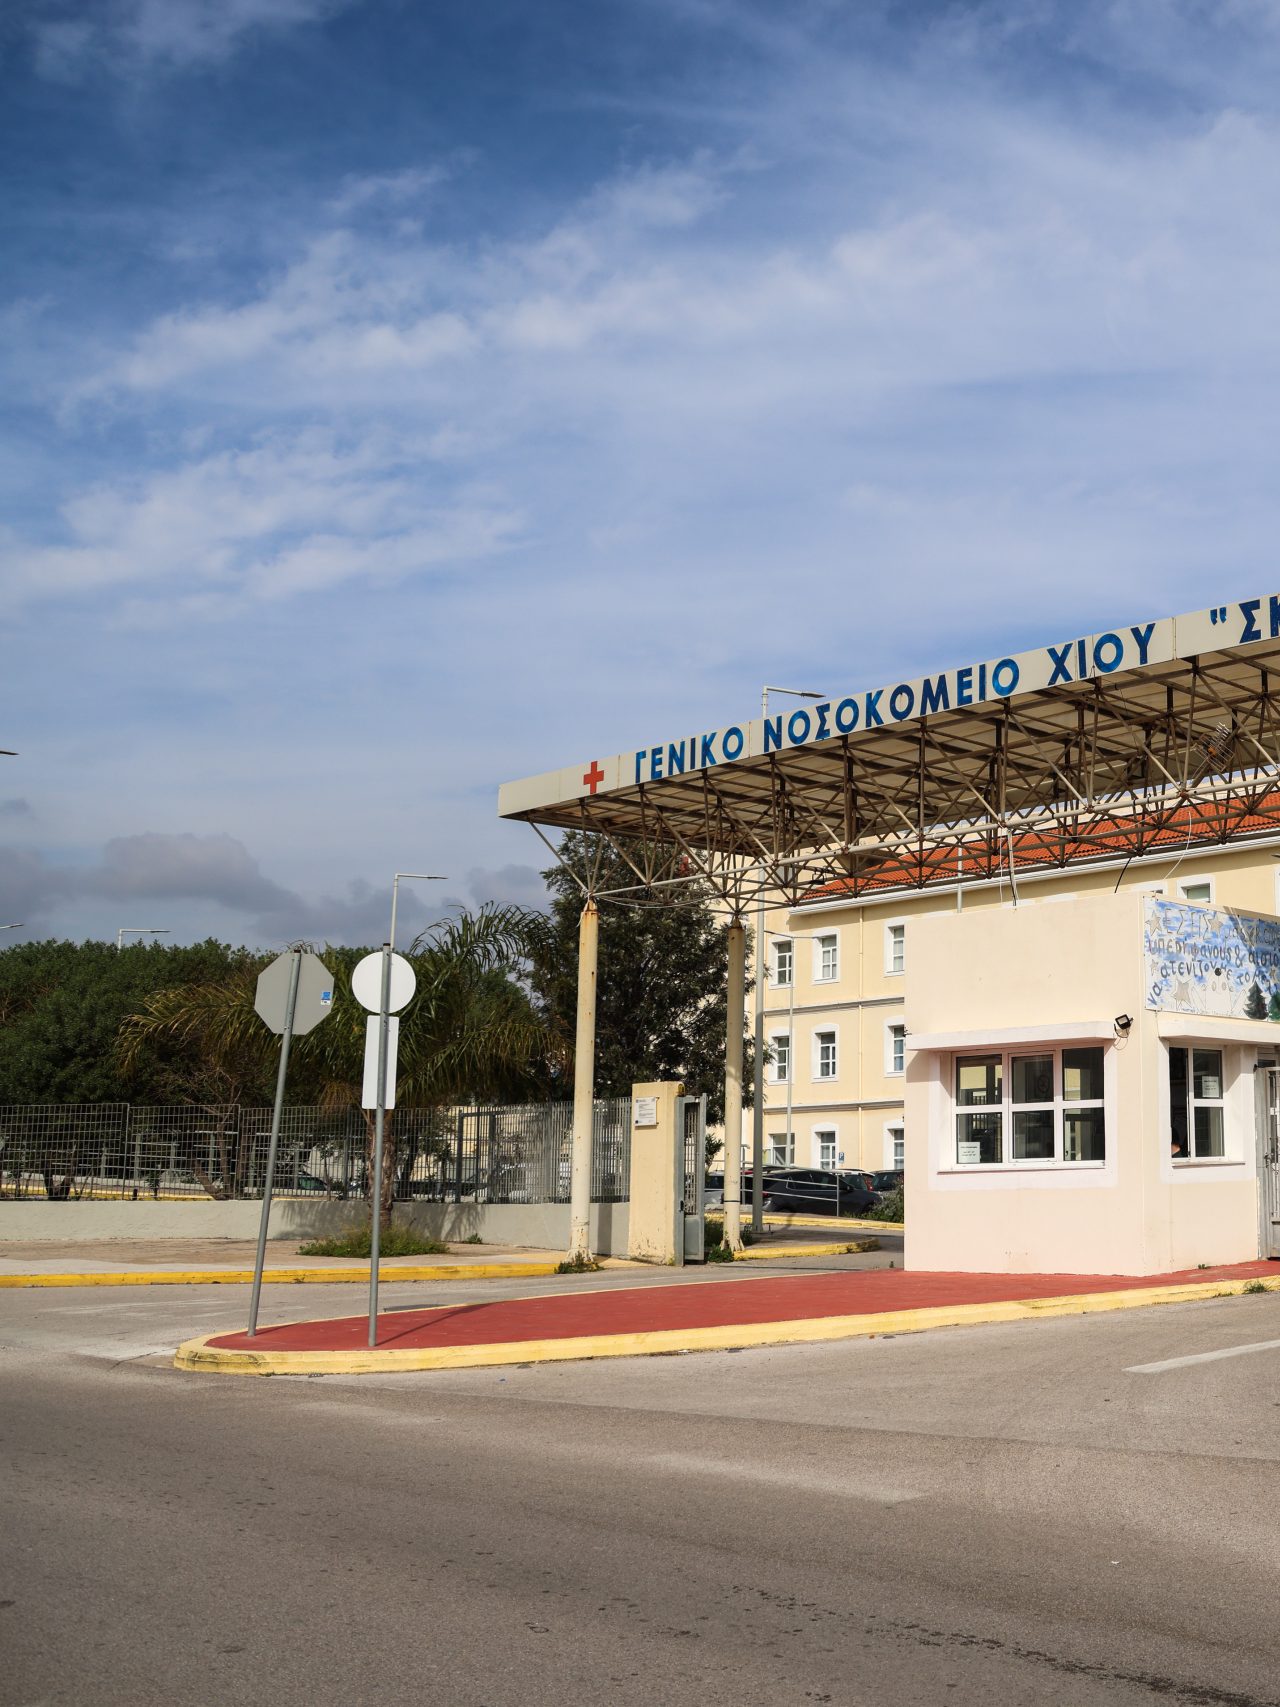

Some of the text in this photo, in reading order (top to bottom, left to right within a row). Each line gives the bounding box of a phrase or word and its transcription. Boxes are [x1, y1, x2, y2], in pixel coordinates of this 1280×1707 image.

[634, 726, 744, 783] ΓΕΝΙΚΟ
[763, 658, 1020, 753] ΝΟΣΟΚΟΜΕΙΟ
[1047, 622, 1157, 685] ΧΙΟΥ
